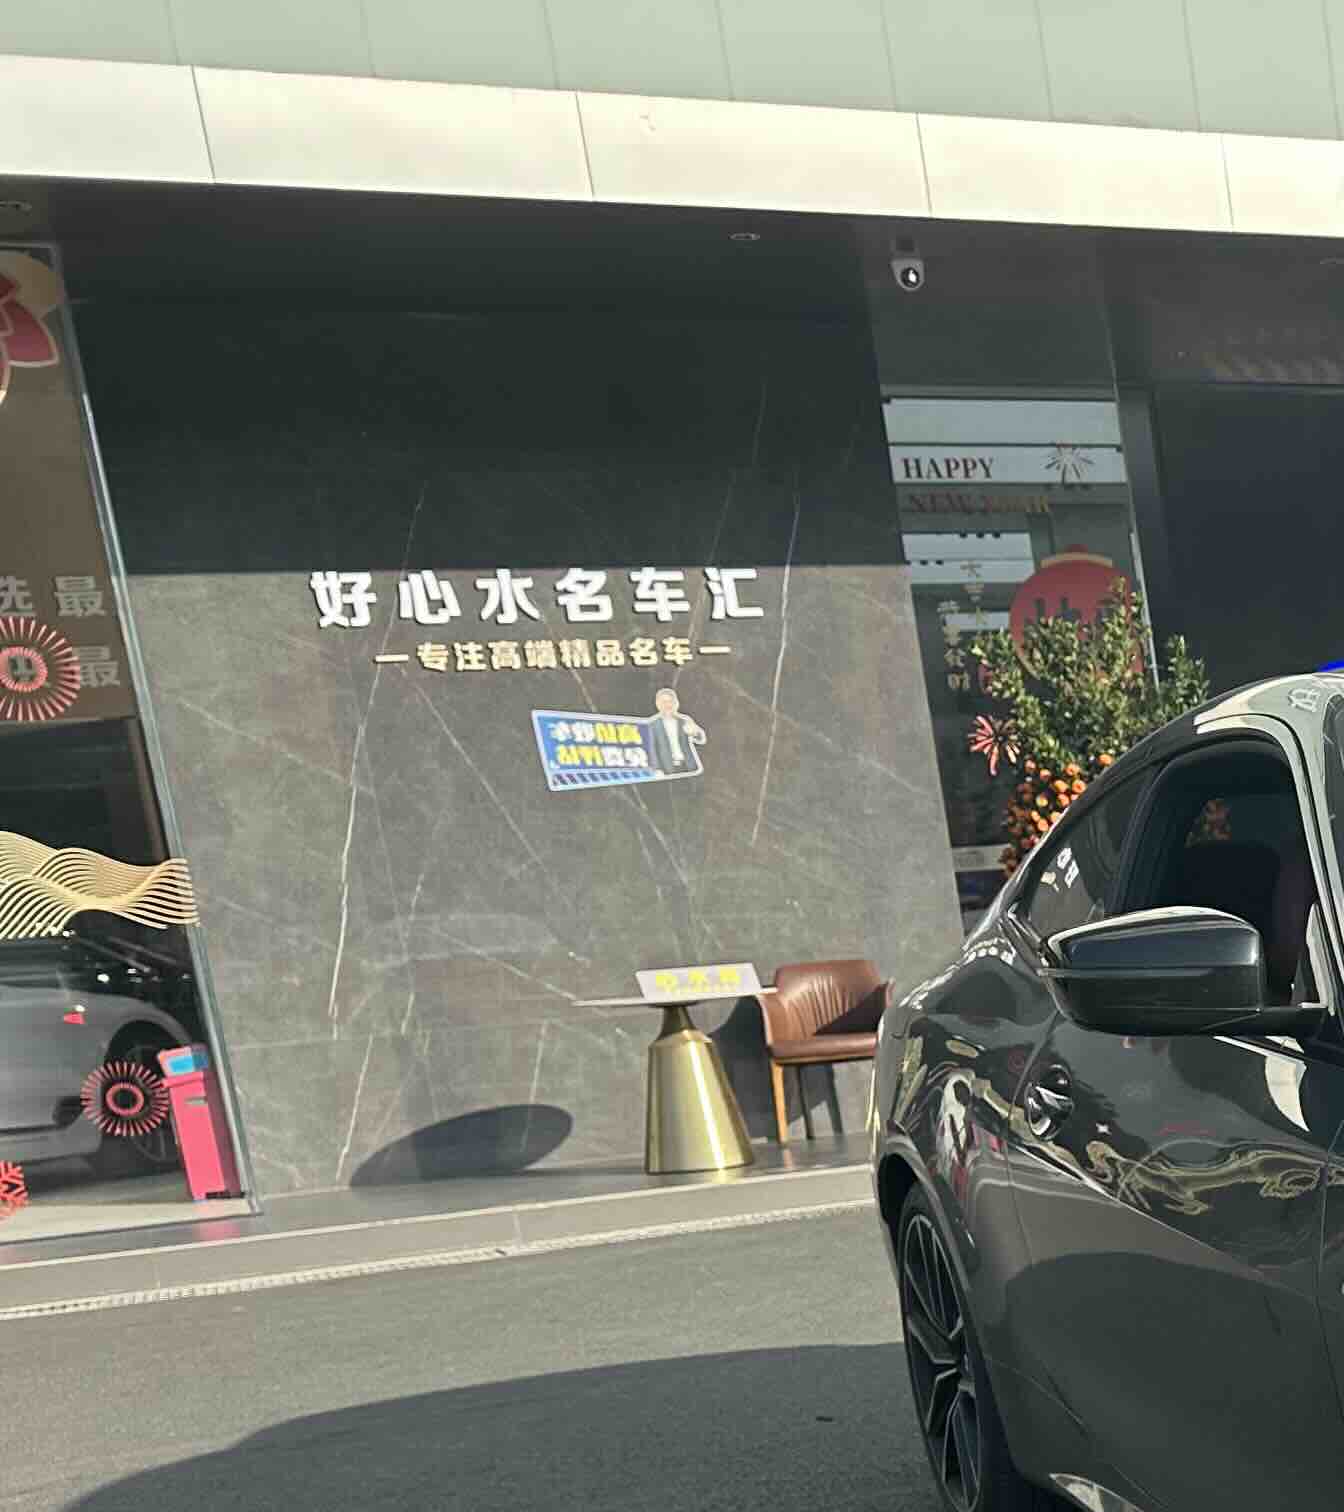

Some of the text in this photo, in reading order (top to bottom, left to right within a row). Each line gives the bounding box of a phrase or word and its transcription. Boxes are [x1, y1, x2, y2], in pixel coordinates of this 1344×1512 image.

[901, 456, 994, 480] HAPPY
[309, 567, 764, 628] 好心水名车汇
[415, 637, 694, 672] 专注高端精品名车
